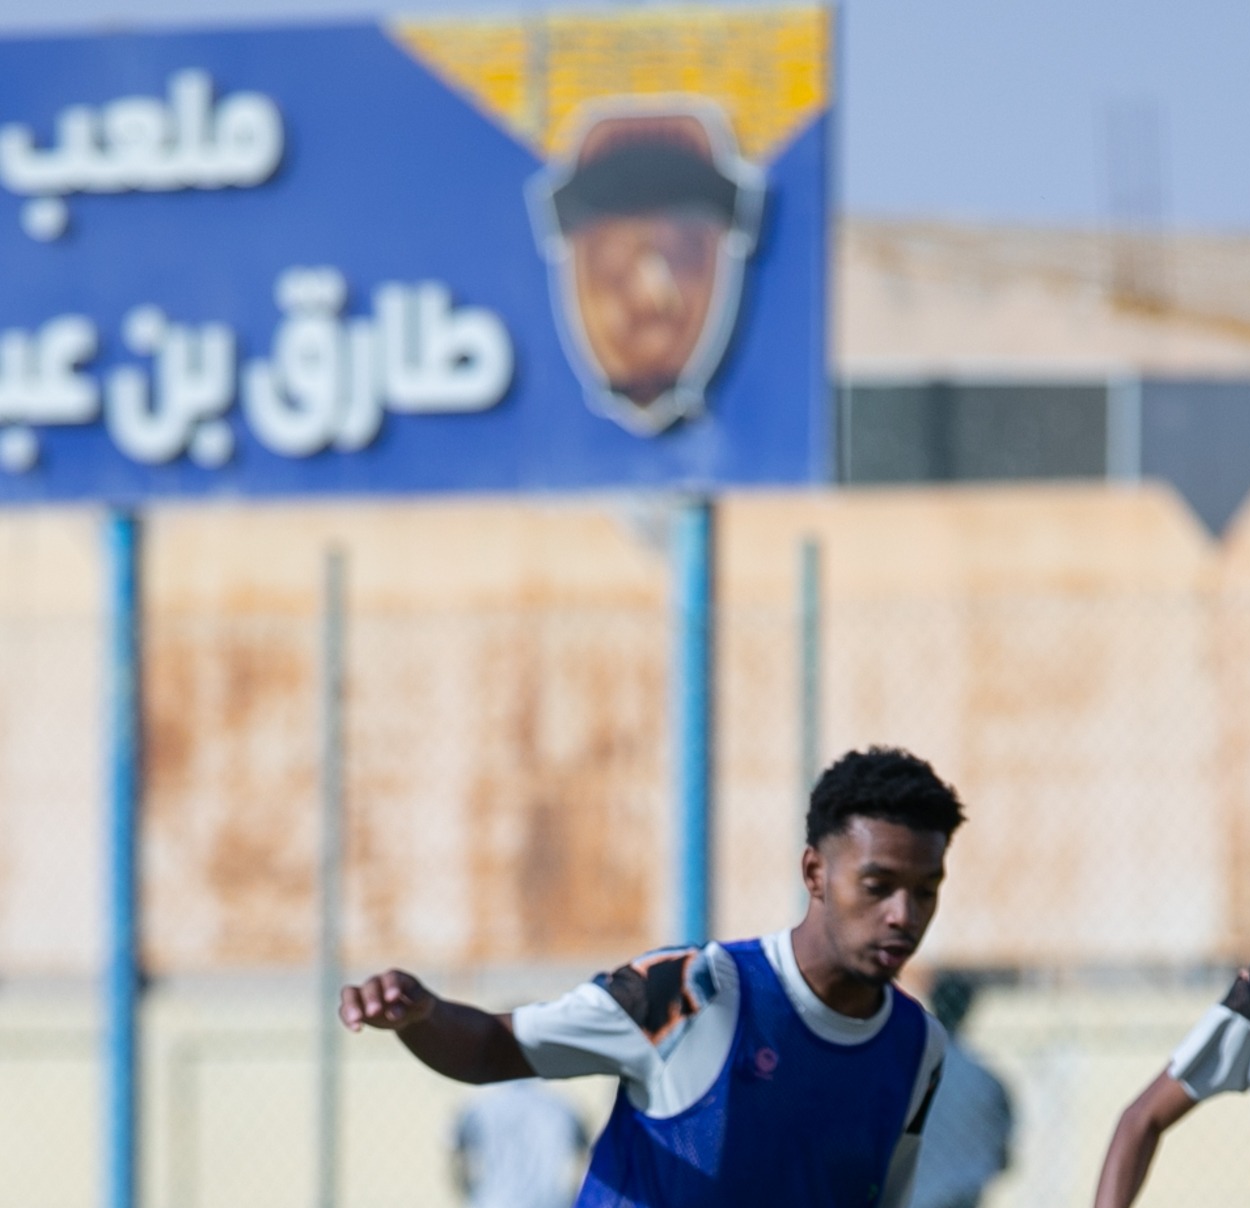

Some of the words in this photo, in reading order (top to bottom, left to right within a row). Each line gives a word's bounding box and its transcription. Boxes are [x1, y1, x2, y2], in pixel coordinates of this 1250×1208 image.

[1, 68, 284, 241] ملعب
[0, 314, 99, 474] عب
[104, 303, 236, 470] بن
[241, 266, 515, 457] طارق
